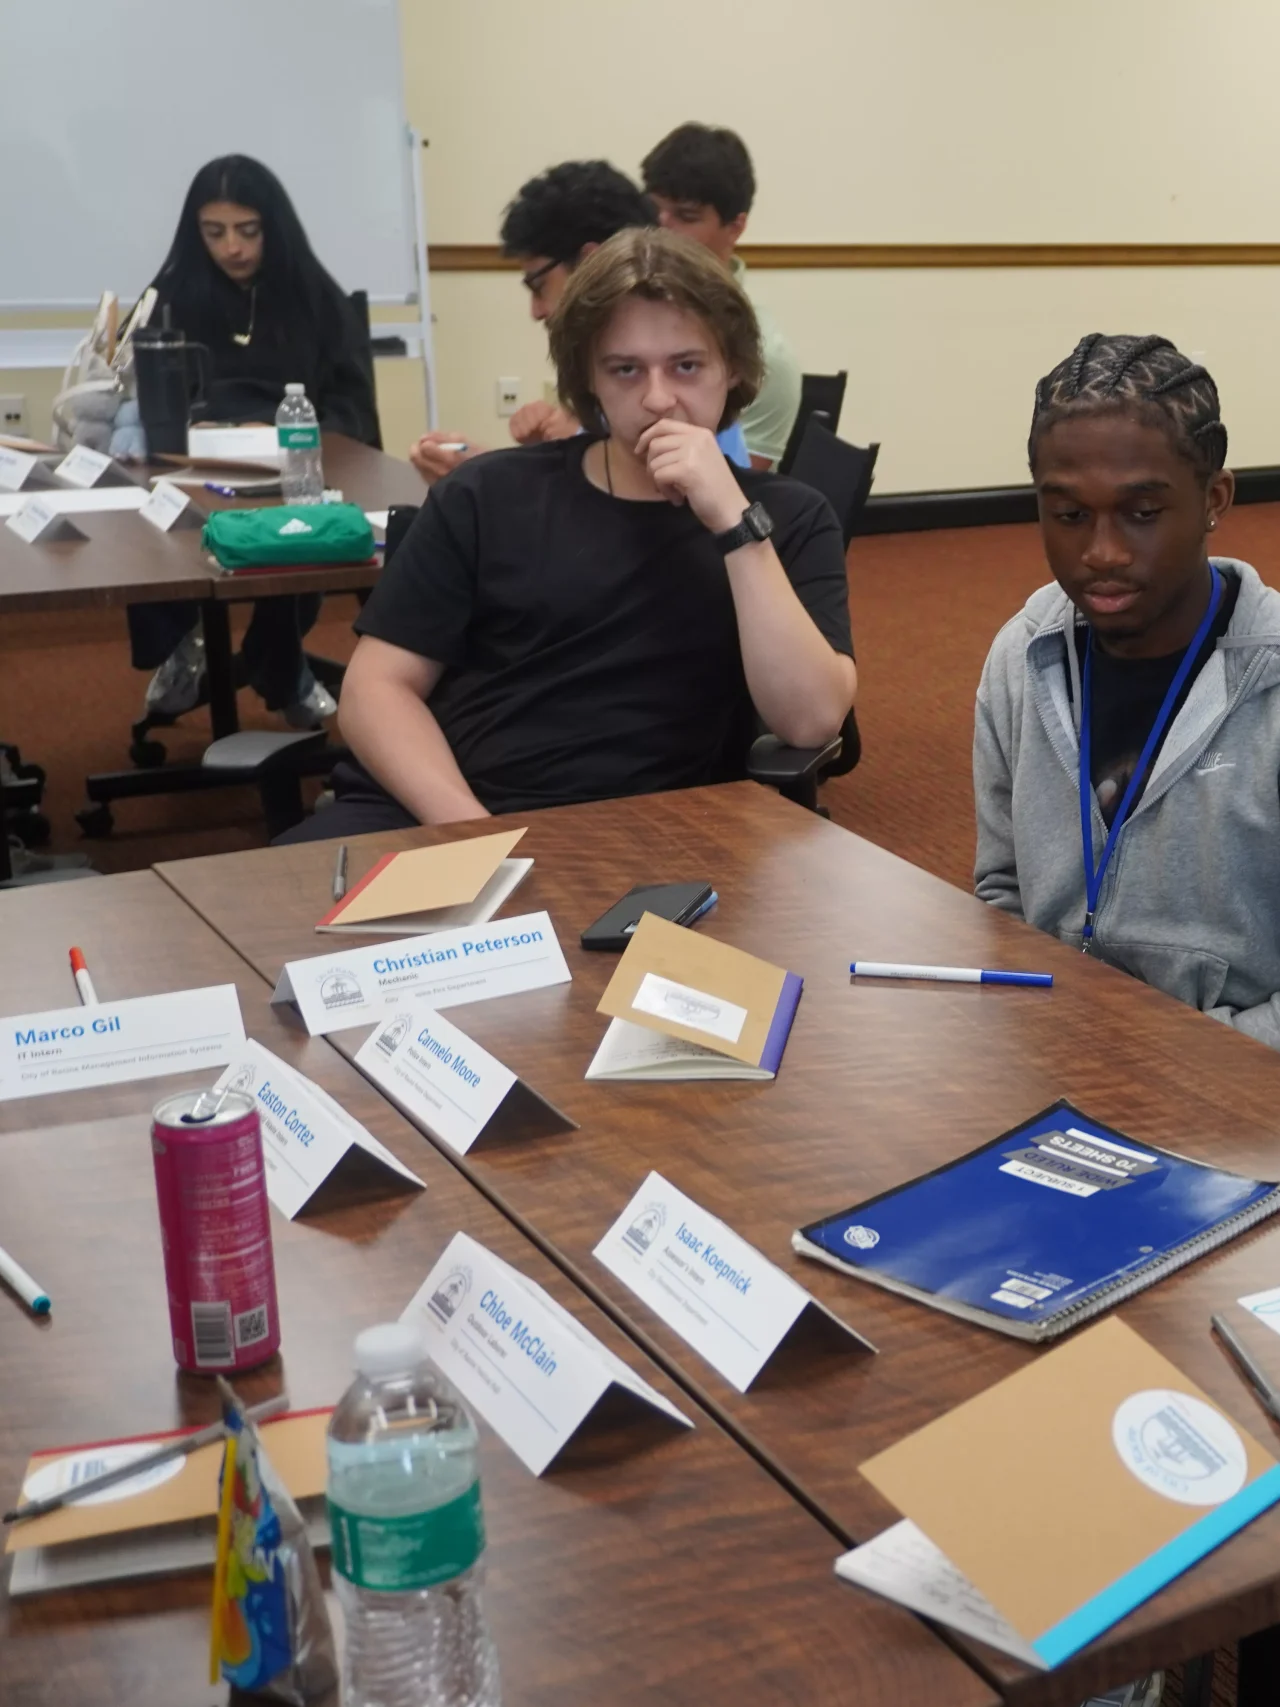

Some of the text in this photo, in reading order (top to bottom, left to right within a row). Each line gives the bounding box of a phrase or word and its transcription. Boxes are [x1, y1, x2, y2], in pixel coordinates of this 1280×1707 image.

[373, 930, 544, 975] Christian Peterson
[378, 972, 420, 987] Mechanic
[15, 1016, 121, 1046] Marco Gil
[17, 1048, 63, 1061] IT Intern
[81, 1057, 136, 1072] Management
[138, 1049, 188, 1062] Information
[189, 1043, 223, 1056] Systems
[417, 1028, 481, 1088] Carmelo Moore
[257, 1081, 315, 1147] Easton Cortez
[1023, 1152, 1119, 1187] WIDE RULED
[1049, 1135, 1138, 1172] 70 SHEETS
[1015, 1166, 1077, 1190] SUBJECT
[675, 1222, 752, 1296] Isaac Koepnick
[480, 1289, 513, 1331] Chloe
[509, 1320, 558, 1376] McClain
